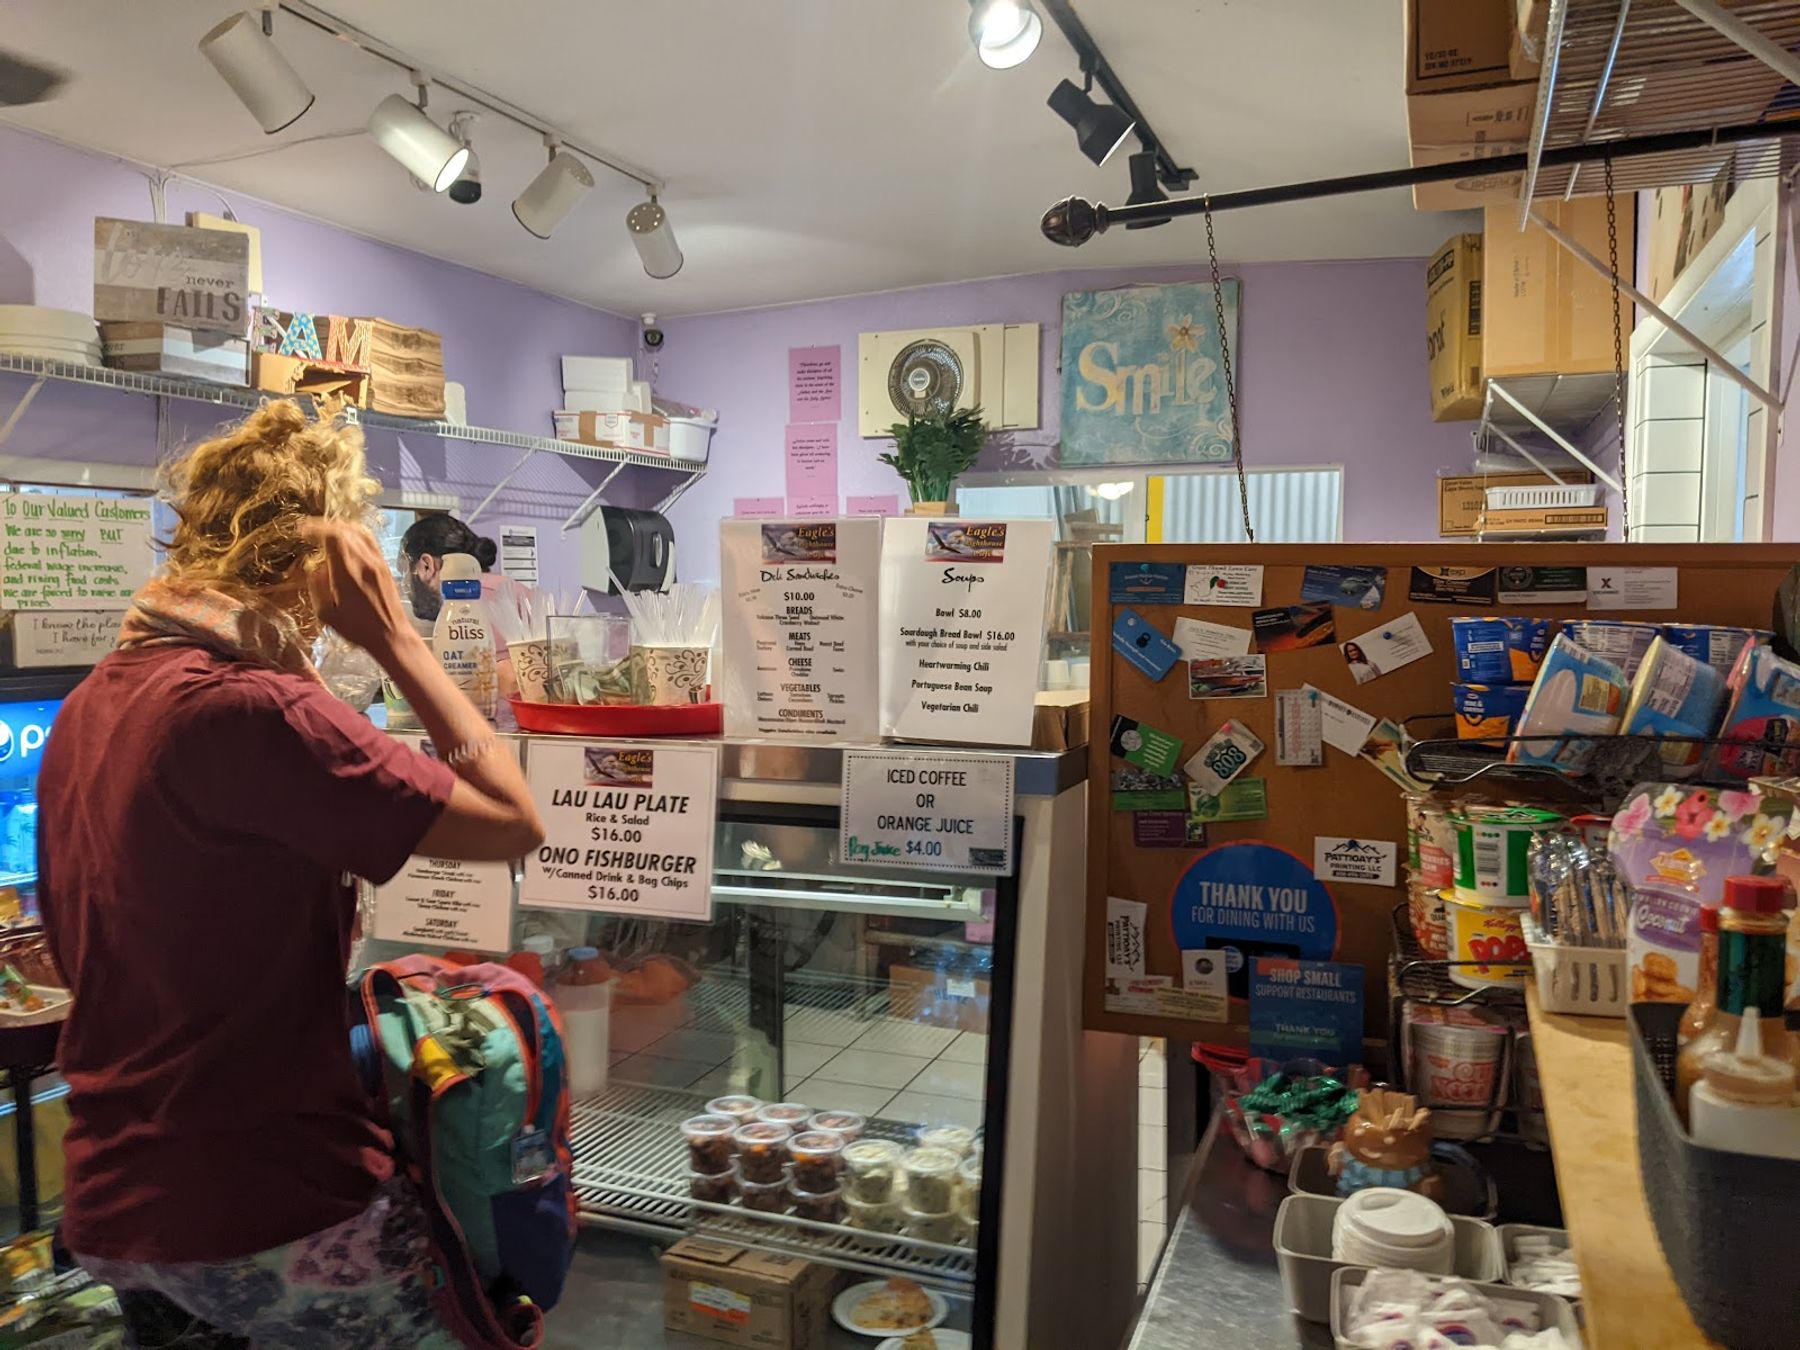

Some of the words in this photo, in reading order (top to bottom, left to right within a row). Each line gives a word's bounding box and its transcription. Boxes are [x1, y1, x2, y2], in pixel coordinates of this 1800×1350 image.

[185, 275, 235, 288] never
[157, 287, 240, 321] FAILS
[1076, 341, 1218, 416] Smile
[4, 499, 17, 516] To
[23, 500, 44, 517] Our
[47, 499, 89, 518] Valued
[95, 500, 151, 519] Customers
[5, 524, 21, 537] We
[25, 528, 42, 537] are
[46, 529, 57, 537] so
[60, 529, 85, 540] sorry
[799, 527, 834, 538] Eagle's
[966, 525, 1005, 539] Eagle's
[4, 541, 24, 556] due
[4, 574, 23, 584] and
[28, 575, 60, 588] rising
[65, 572, 87, 587] food
[760, 568, 783, 582] Deli
[786, 568, 840, 582] Sandwiches
[942, 567, 984, 592] Soups
[41, 584, 72, 600] forced
[78, 586, 88, 597] to
[784, 592, 815, 601] $10.00
[786, 607, 813, 615] BREADS
[936, 608, 954, 617] Bowl
[958, 609, 982, 618] $8.00
[41, 617, 73, 629] know
[76, 616, 95, 629] the
[452, 617, 479, 625] natural
[62, 631, 88, 642] have
[91, 633, 107, 647] for
[448, 626, 484, 641] bliss
[789, 632, 811, 641] MEATS
[900, 627, 938, 639] Sourdough
[939, 630, 961, 639] Bread
[963, 630, 982, 639] Bowl
[987, 631, 1015, 641] $16.00
[443, 651, 464, 661] OAT
[788, 658, 812, 667] CHEESE
[919, 659, 971, 672] Heartwarming
[973, 661, 989, 671] Chili
[780, 684, 821, 693] VEGETABLES
[911, 680, 952, 692] Portuguese
[954, 682, 972, 691] Bean
[975, 683, 993, 694] Soup
[779, 709, 823, 719] CONDIMENTS
[921, 701, 961, 712] Vegetarian
[963, 703, 979, 713] Chili
[618, 751, 652, 765] Eagle's
[1212, 745, 1247, 779] 808
[887, 769, 915, 785] ICED
[919, 770, 967, 787] COFFEE
[552, 789, 588, 807] LAU
[592, 791, 629, 810] LAU
[634, 794, 690, 814] PLATE
[916, 793, 935, 809] OR
[585, 813, 607, 823] Rice
[609, 814, 618, 824] &
[621, 814, 650, 826] Salad
[877, 815, 932, 833] ORANGE
[936, 818, 974, 835] JUICE
[591, 827, 642, 843] $16.00
[906, 840, 942, 857] $4.00
[429, 859, 462, 869] THURSDAY
[538, 846, 579, 865] ONO
[584, 849, 697, 875] FISHBURGER
[1330, 862, 1365, 871] PRINTING
[1367, 864, 1382, 872] LLC
[542, 866, 592, 881] w/Canned
[596, 871, 623, 883] Drink
[626, 874, 635, 884] &
[638, 875, 658, 888] Bag
[661, 876, 688, 890] Chips
[432, 889, 455, 898] FRIDAY
[587, 885, 640, 902] $16.00
[1200, 881, 1263, 912] THANK
[1268, 888, 1307, 913] YOU
[425, 918, 459, 928] SATURDAY
[1191, 906, 1214, 924] FOR
[1217, 909, 1260, 929] DINING
[1263, 914, 1294, 932] WITH
[1300, 916, 1315, 933] US
[1637, 904, 1690, 935] Coconut
[1269, 968, 1301, 984] SHOP
[1303, 971, 1342, 988] SMALL
[1255, 984, 1294, 1000] SUPPORT
[1295, 986, 1356, 1004] RESTAURANTS
[1275, 1023, 1309, 1034] THANK
[1313, 1026, 1335, 1036] YOU
